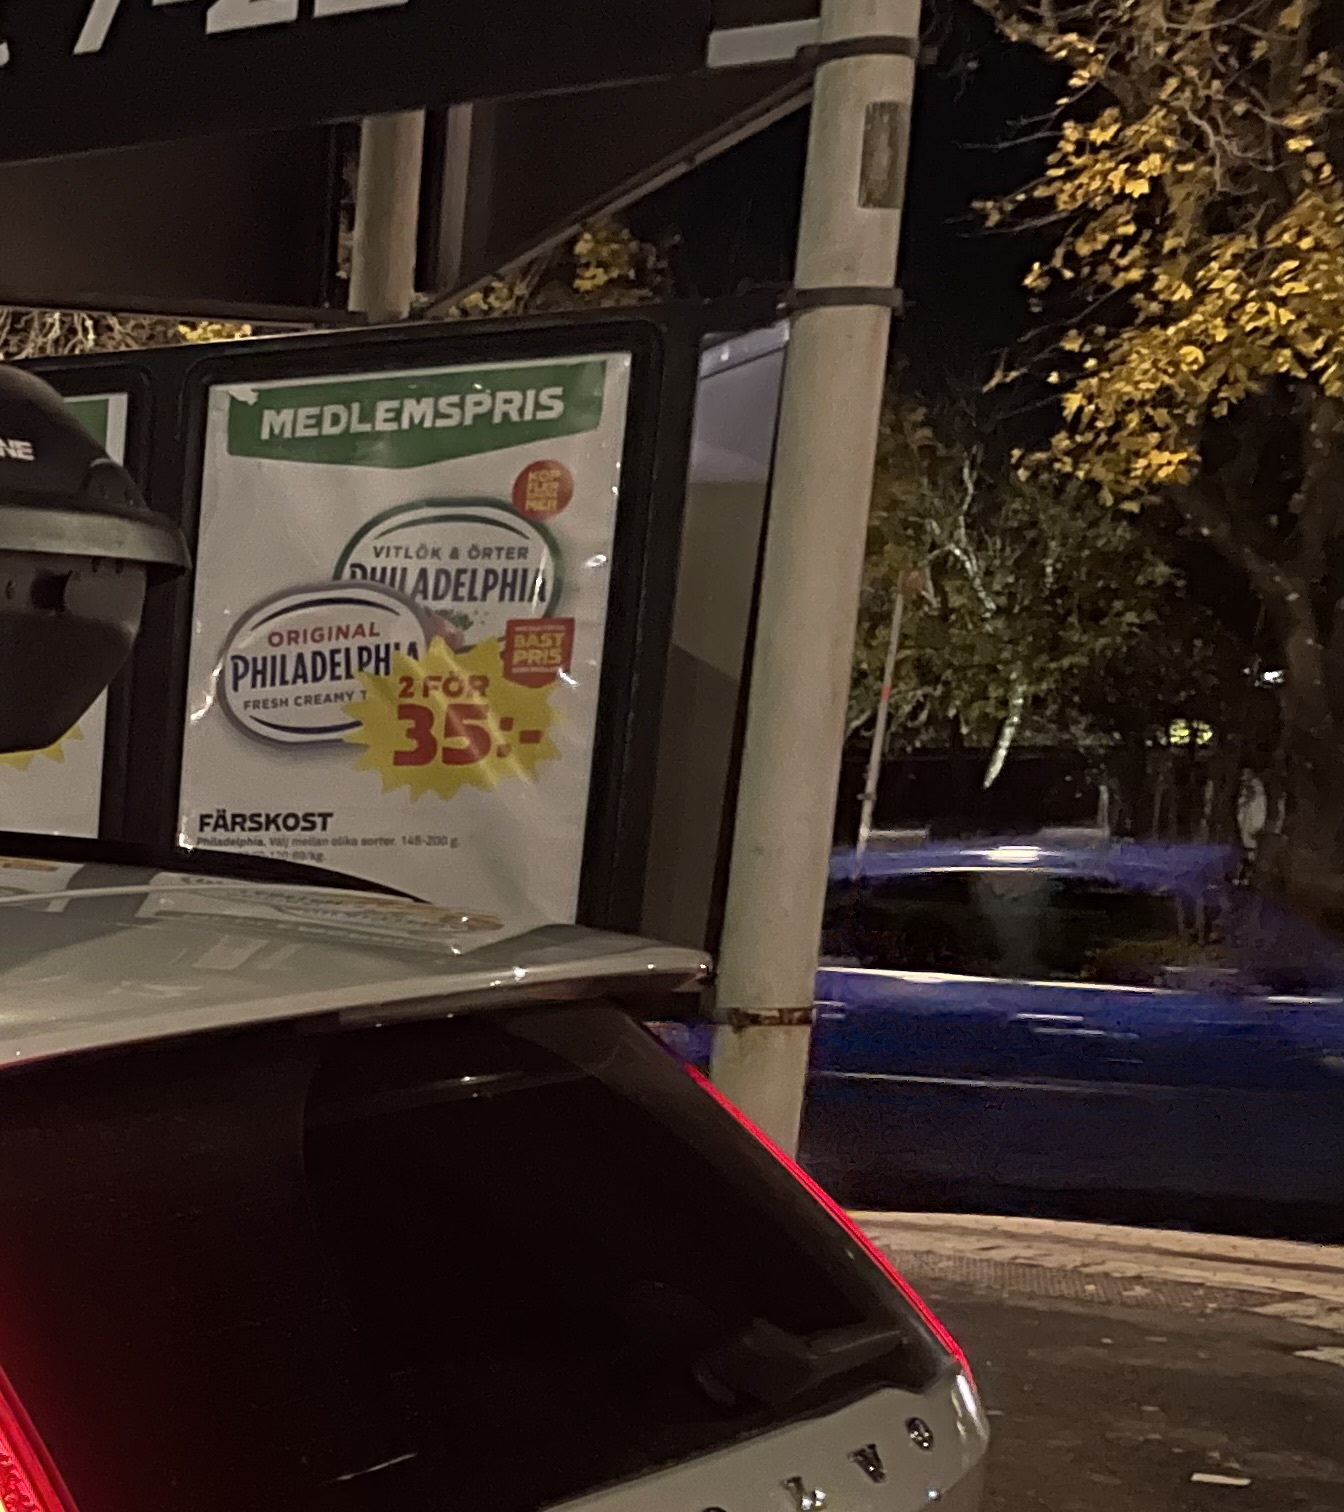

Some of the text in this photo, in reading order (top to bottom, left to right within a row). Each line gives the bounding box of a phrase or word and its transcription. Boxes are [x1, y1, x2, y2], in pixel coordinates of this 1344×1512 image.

[260, 387, 564, 440] MEDLEMSPRIS
[373, 545, 529, 560] VITLÖK & ÖRTER
[267, 622, 380, 648] ORIGINAL
[231, 641, 419, 693] PHILADELPHA
[512, 649, 562, 665] PRIS
[398, 675, 414, 698] 2
[243, 697, 289, 711] FRESH
[293, 693, 354, 709] CREAMY
[393, 704, 544, 766] 35:-
[198, 809, 334, 832] FÄRSKOST
